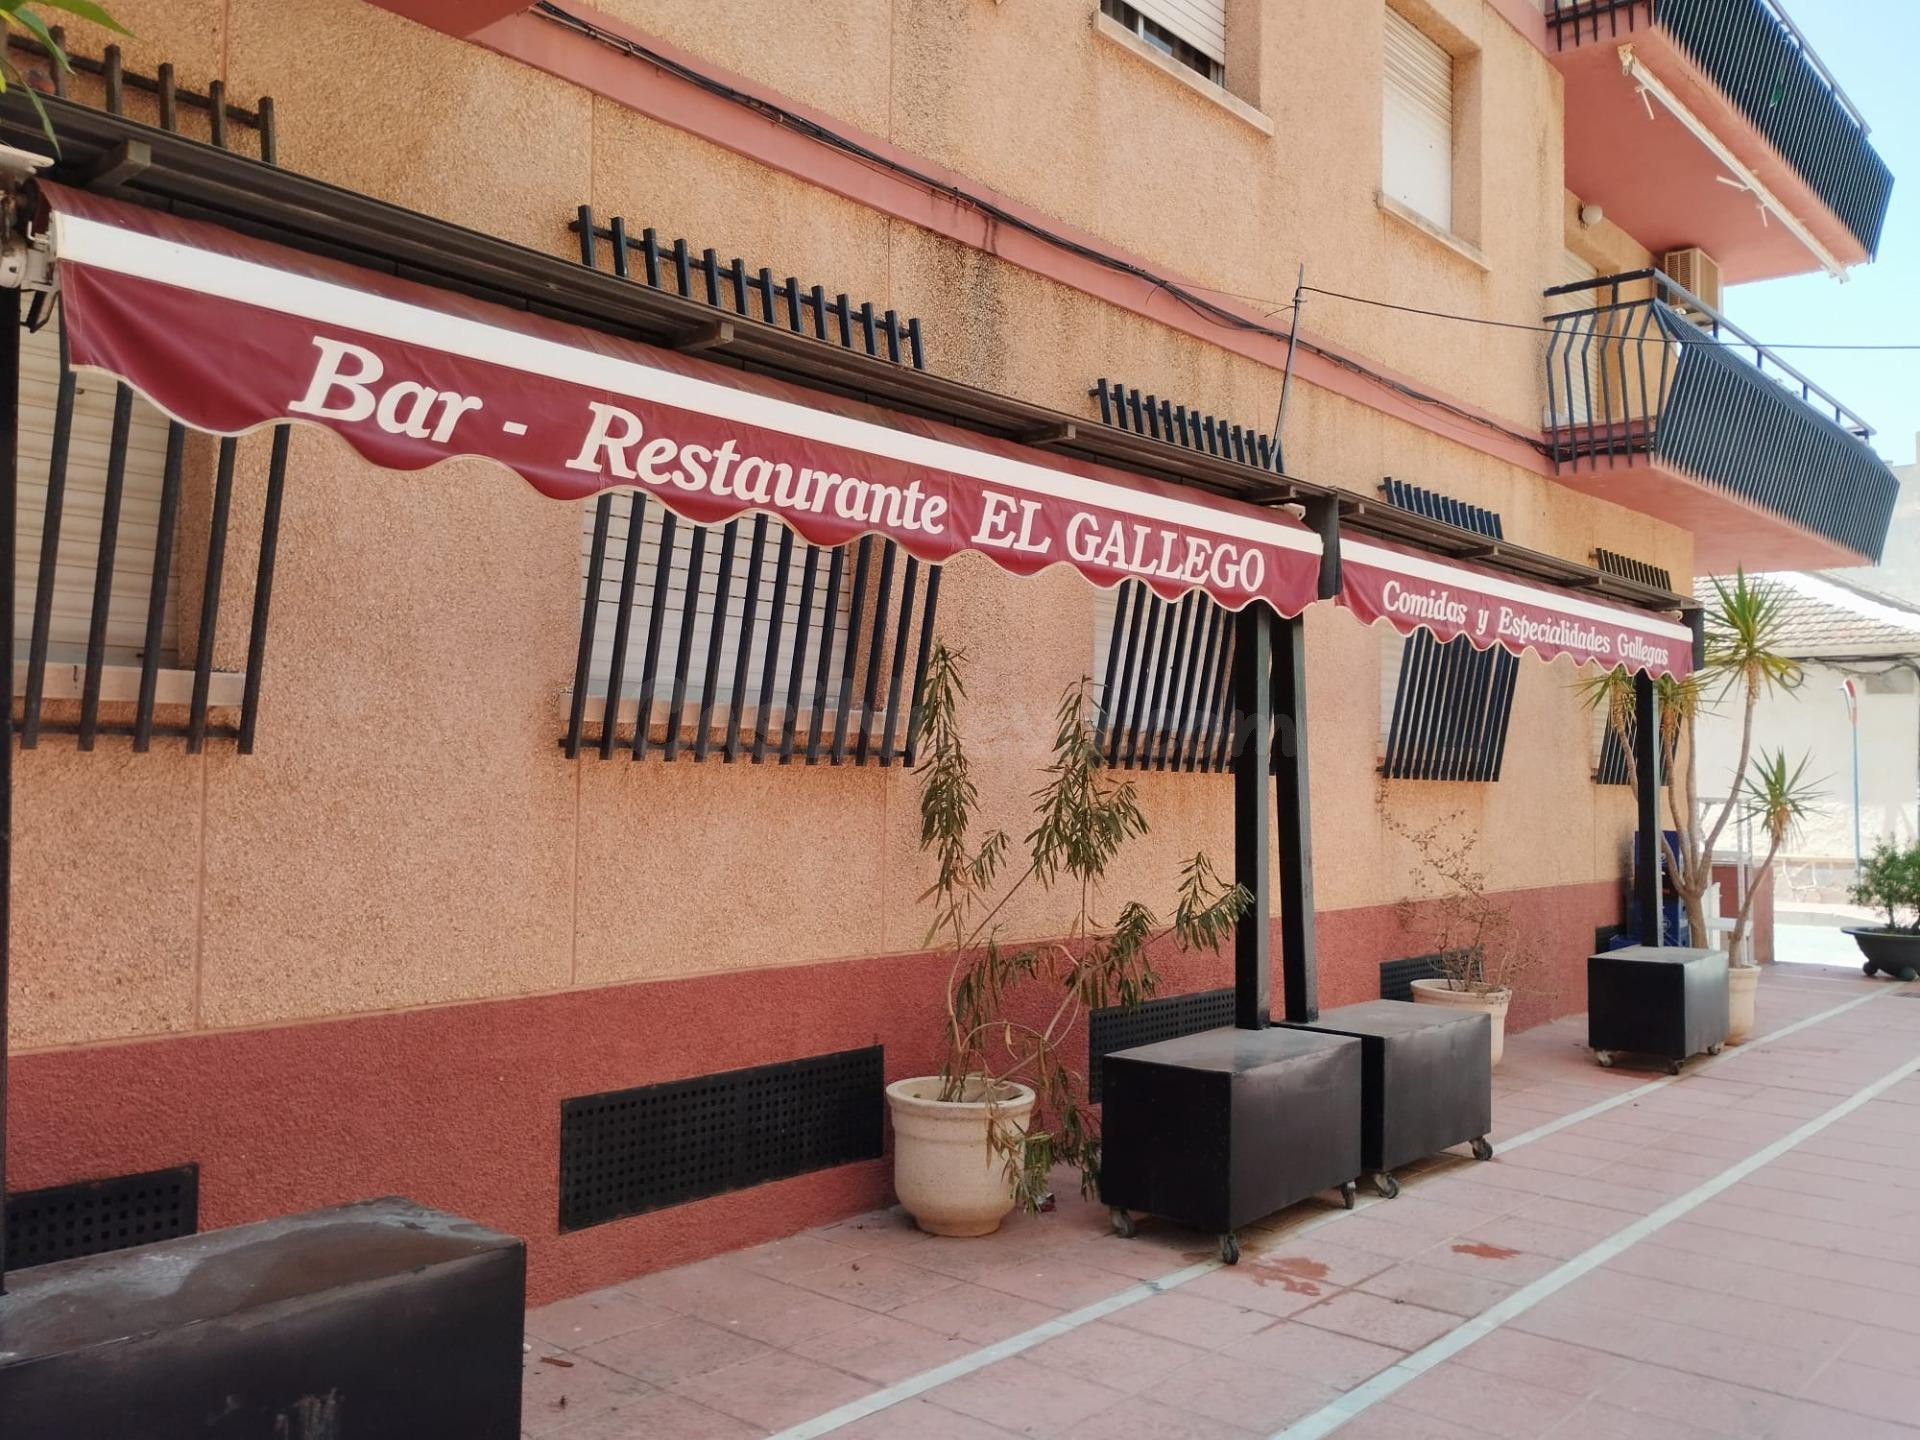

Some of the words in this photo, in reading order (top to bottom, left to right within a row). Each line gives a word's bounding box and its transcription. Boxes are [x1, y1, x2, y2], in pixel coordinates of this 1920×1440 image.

[288, 335, 483, 443] Bar
[502, 421, 528, 436] -
[565, 401, 948, 534] Restaurante
[971, 490, 1052, 554] EL
[1066, 512, 1265, 592] GALLEGO
[1382, 580, 1468, 625] Comidas
[1476, 608, 1490, 636] y
[1497, 606, 1611, 654] Especialidades
[1617, 633, 1669, 668] Gallegas
